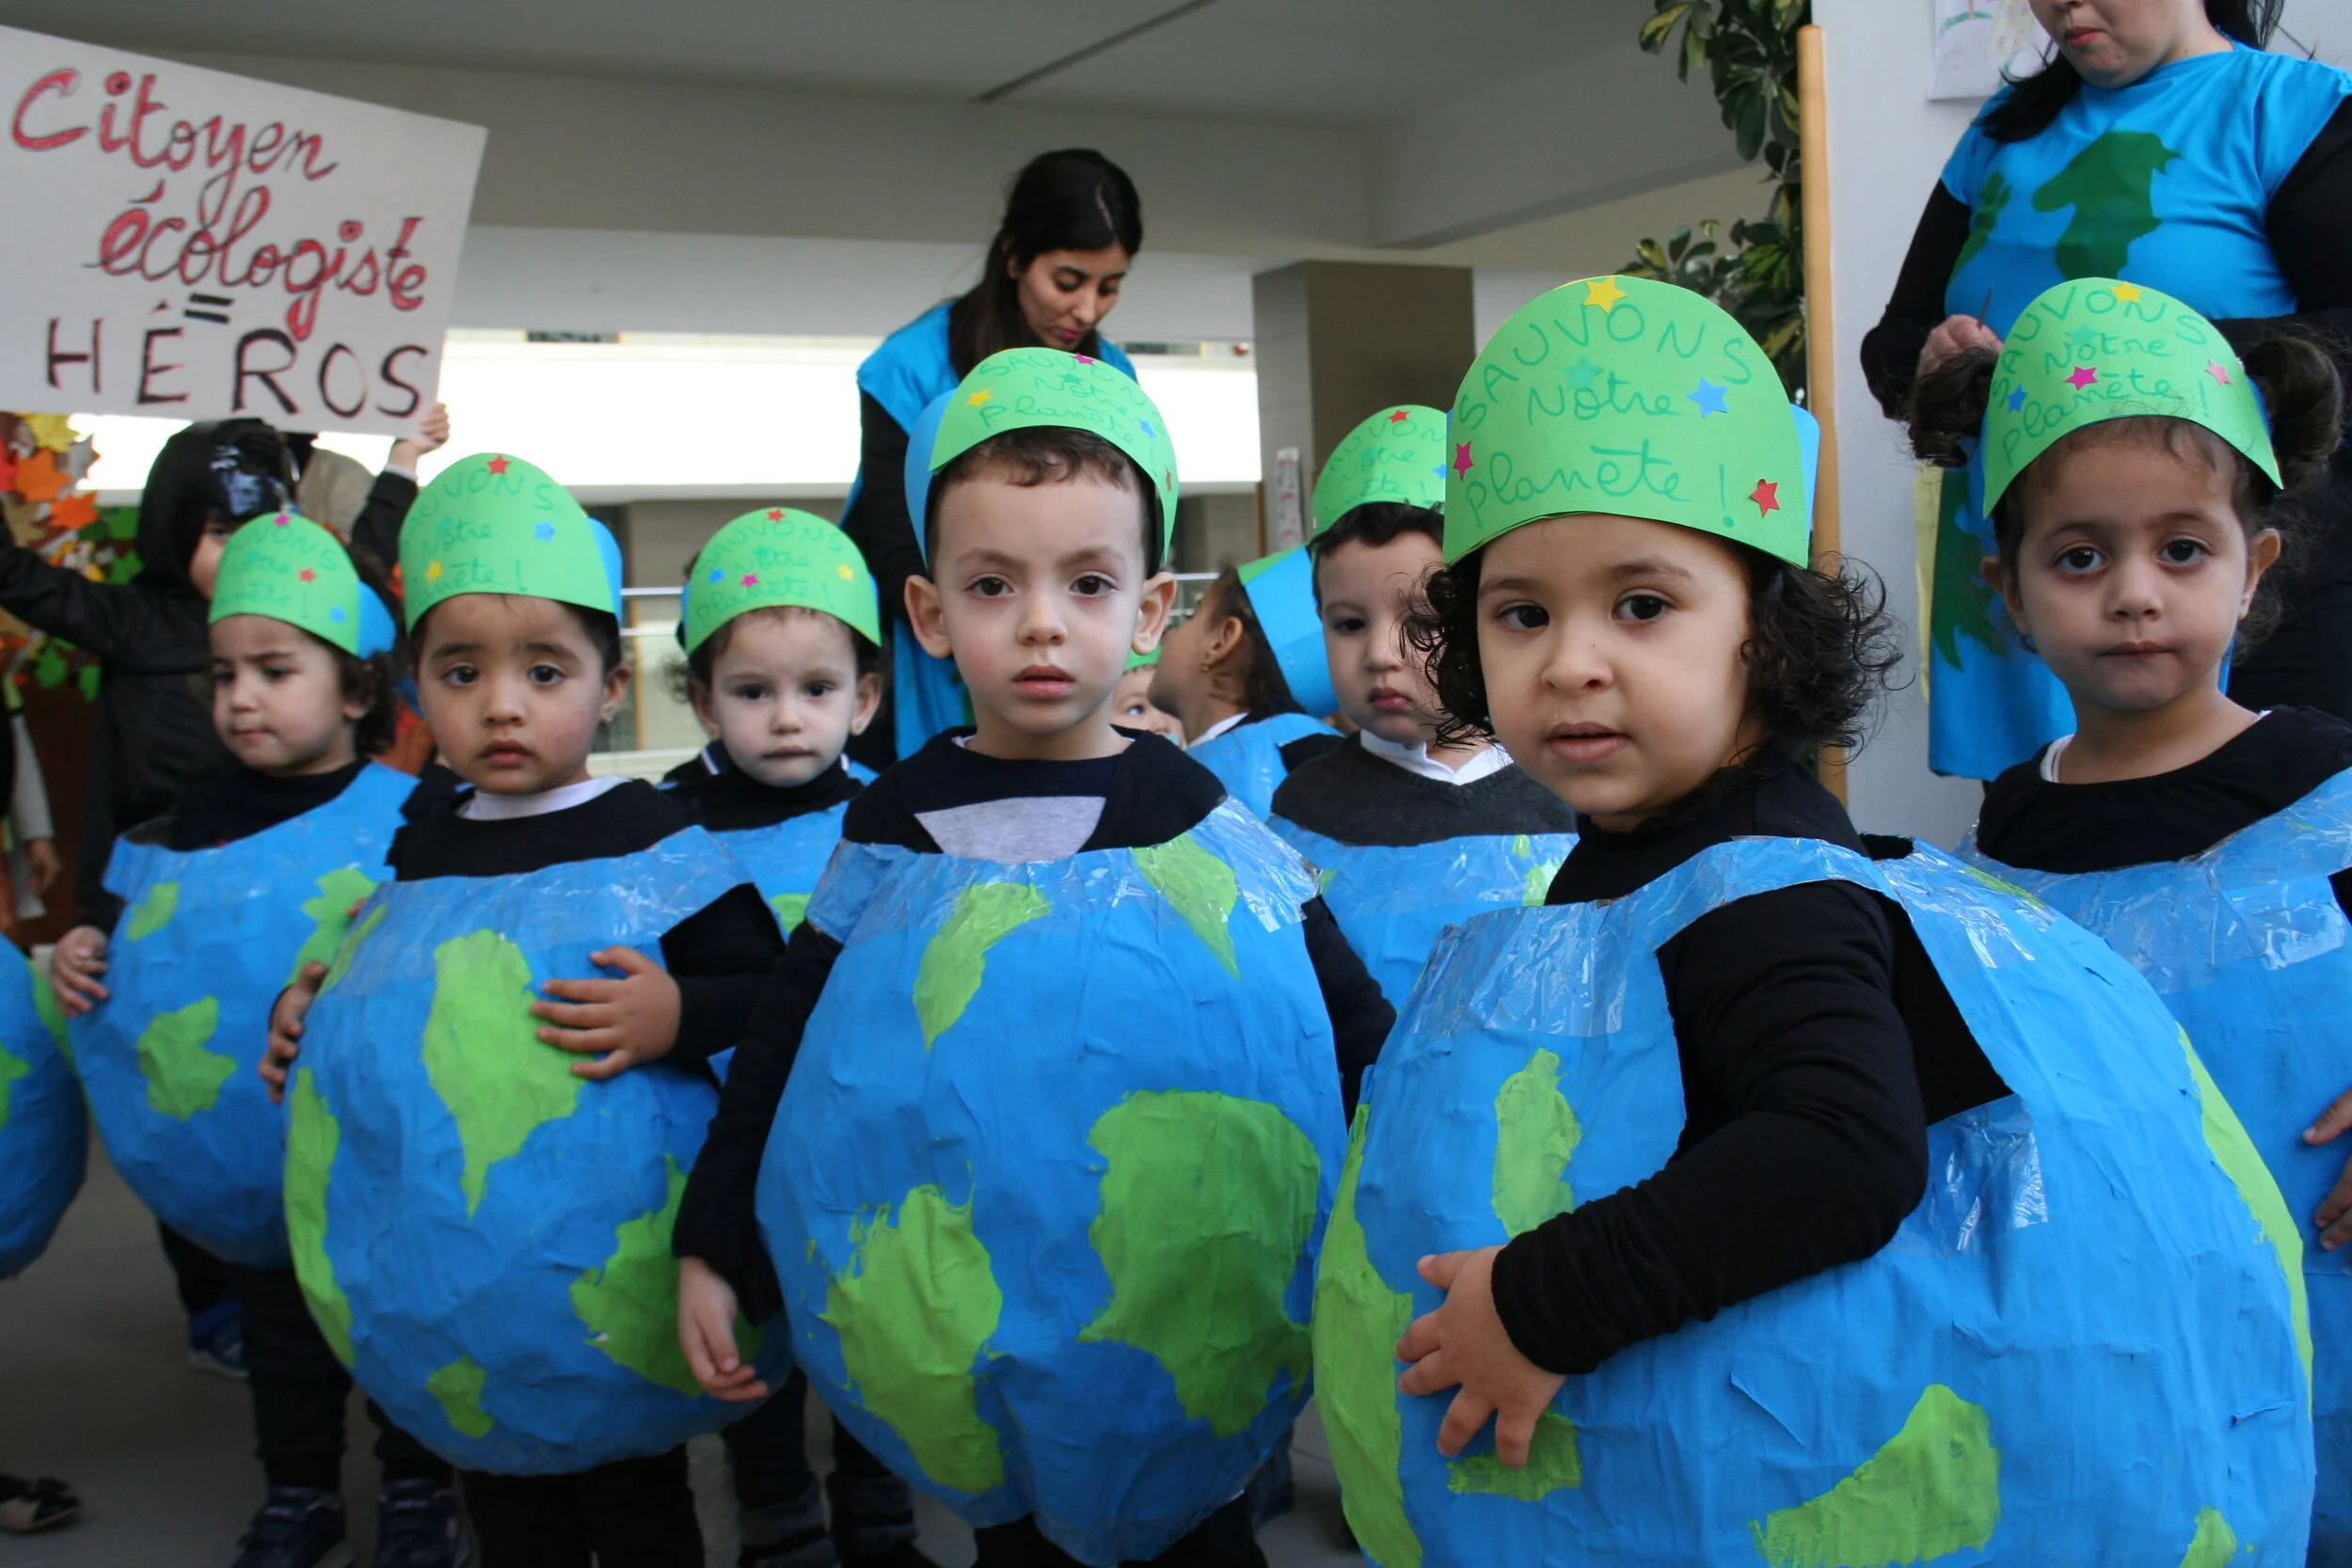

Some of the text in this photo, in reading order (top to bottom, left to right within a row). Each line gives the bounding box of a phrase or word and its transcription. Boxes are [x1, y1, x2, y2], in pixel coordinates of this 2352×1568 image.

[11, 69, 339, 226] Citoyen
[83, 179, 427, 341] écologiste
[44, 299, 430, 420] HÉROS
[977, 353, 1167, 437] SAUVONS
[1035, 376, 1134, 420] Notre
[1458, 303, 1753, 431] SAUVONS
[1527, 371, 1684, 426] Notre
[1992, 285, 2208, 409] SAUVONS
[2043, 331, 2174, 375] Notre
